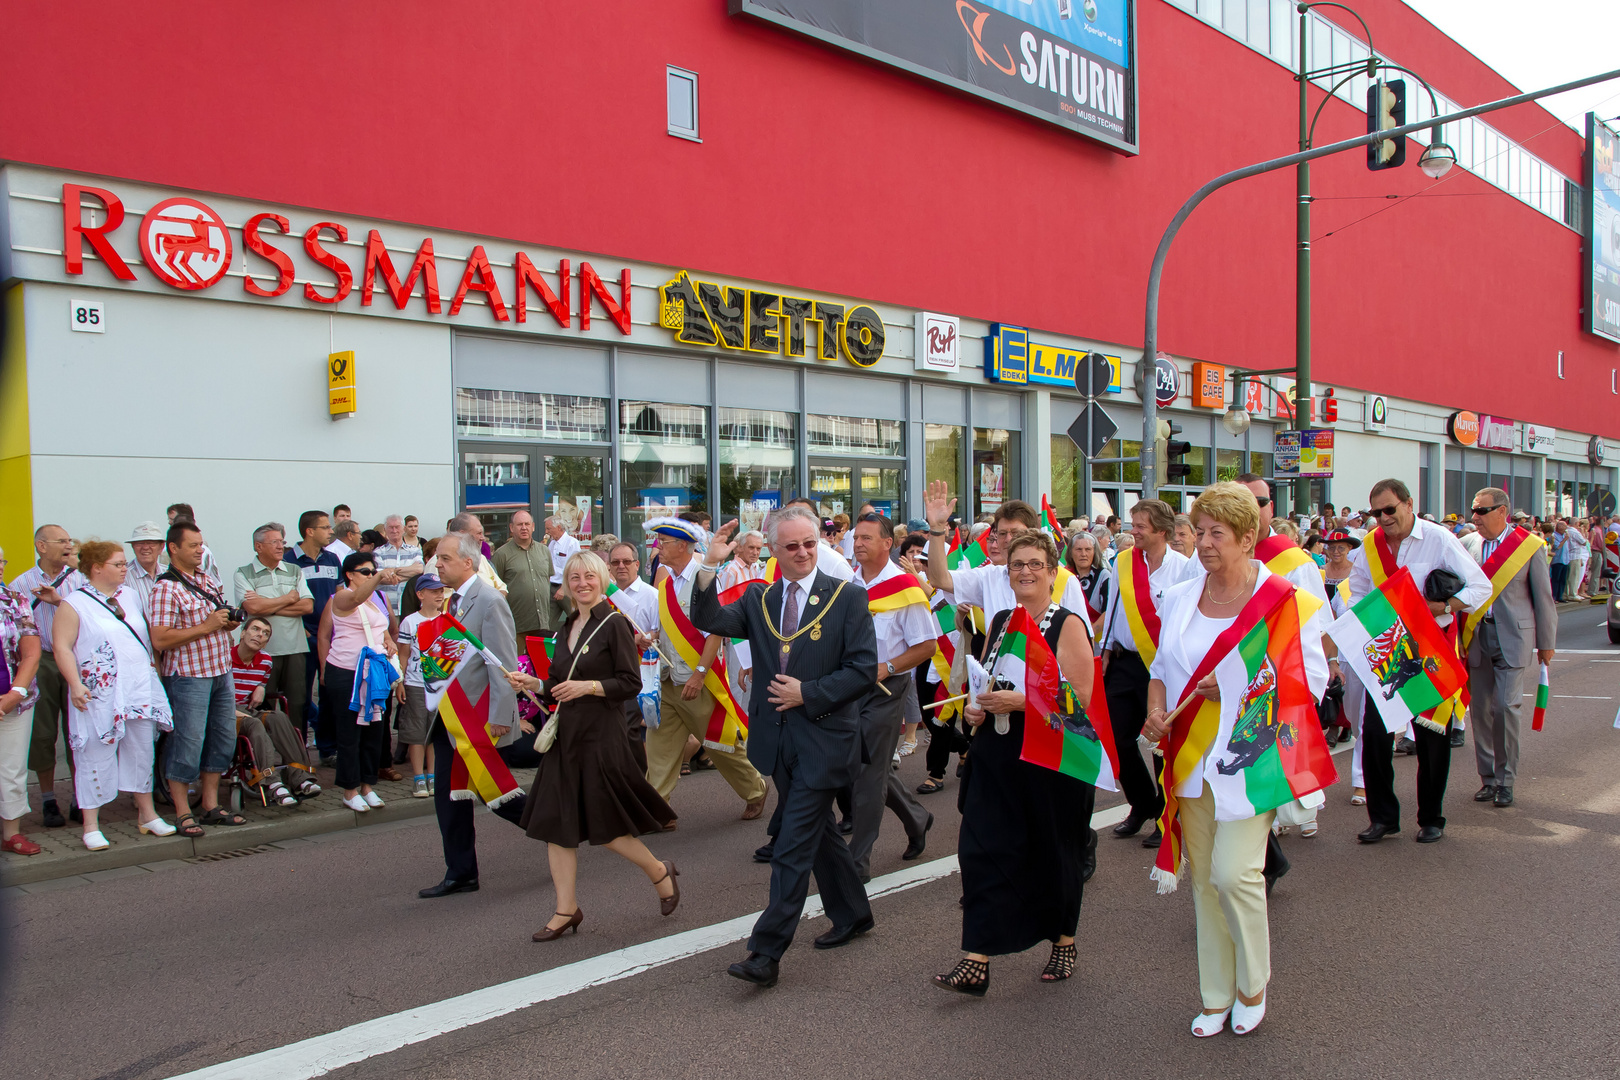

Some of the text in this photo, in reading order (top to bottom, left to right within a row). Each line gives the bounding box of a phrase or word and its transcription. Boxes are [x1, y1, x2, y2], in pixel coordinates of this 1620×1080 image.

[1020, 31, 1124, 121] SATURN
[1060, 102, 1124, 134] SOO! MUSS TECHNIK
[62, 182, 632, 336] ROSSMANN
[76, 307, 100, 325] 85
[660, 270, 886, 368] NETTO
[1002, 370, 1026, 381] EDEKA
[1156, 367, 1176, 391] C&A
[1206, 369, 1219, 383] EIS
[332, 397, 348, 405] DHL
[1202, 381, 1223, 399] CAFÉ
[1480, 415, 1516, 449] ADLER
[475, 464, 504, 486] TH2
[815, 475, 835, 492] TH2
